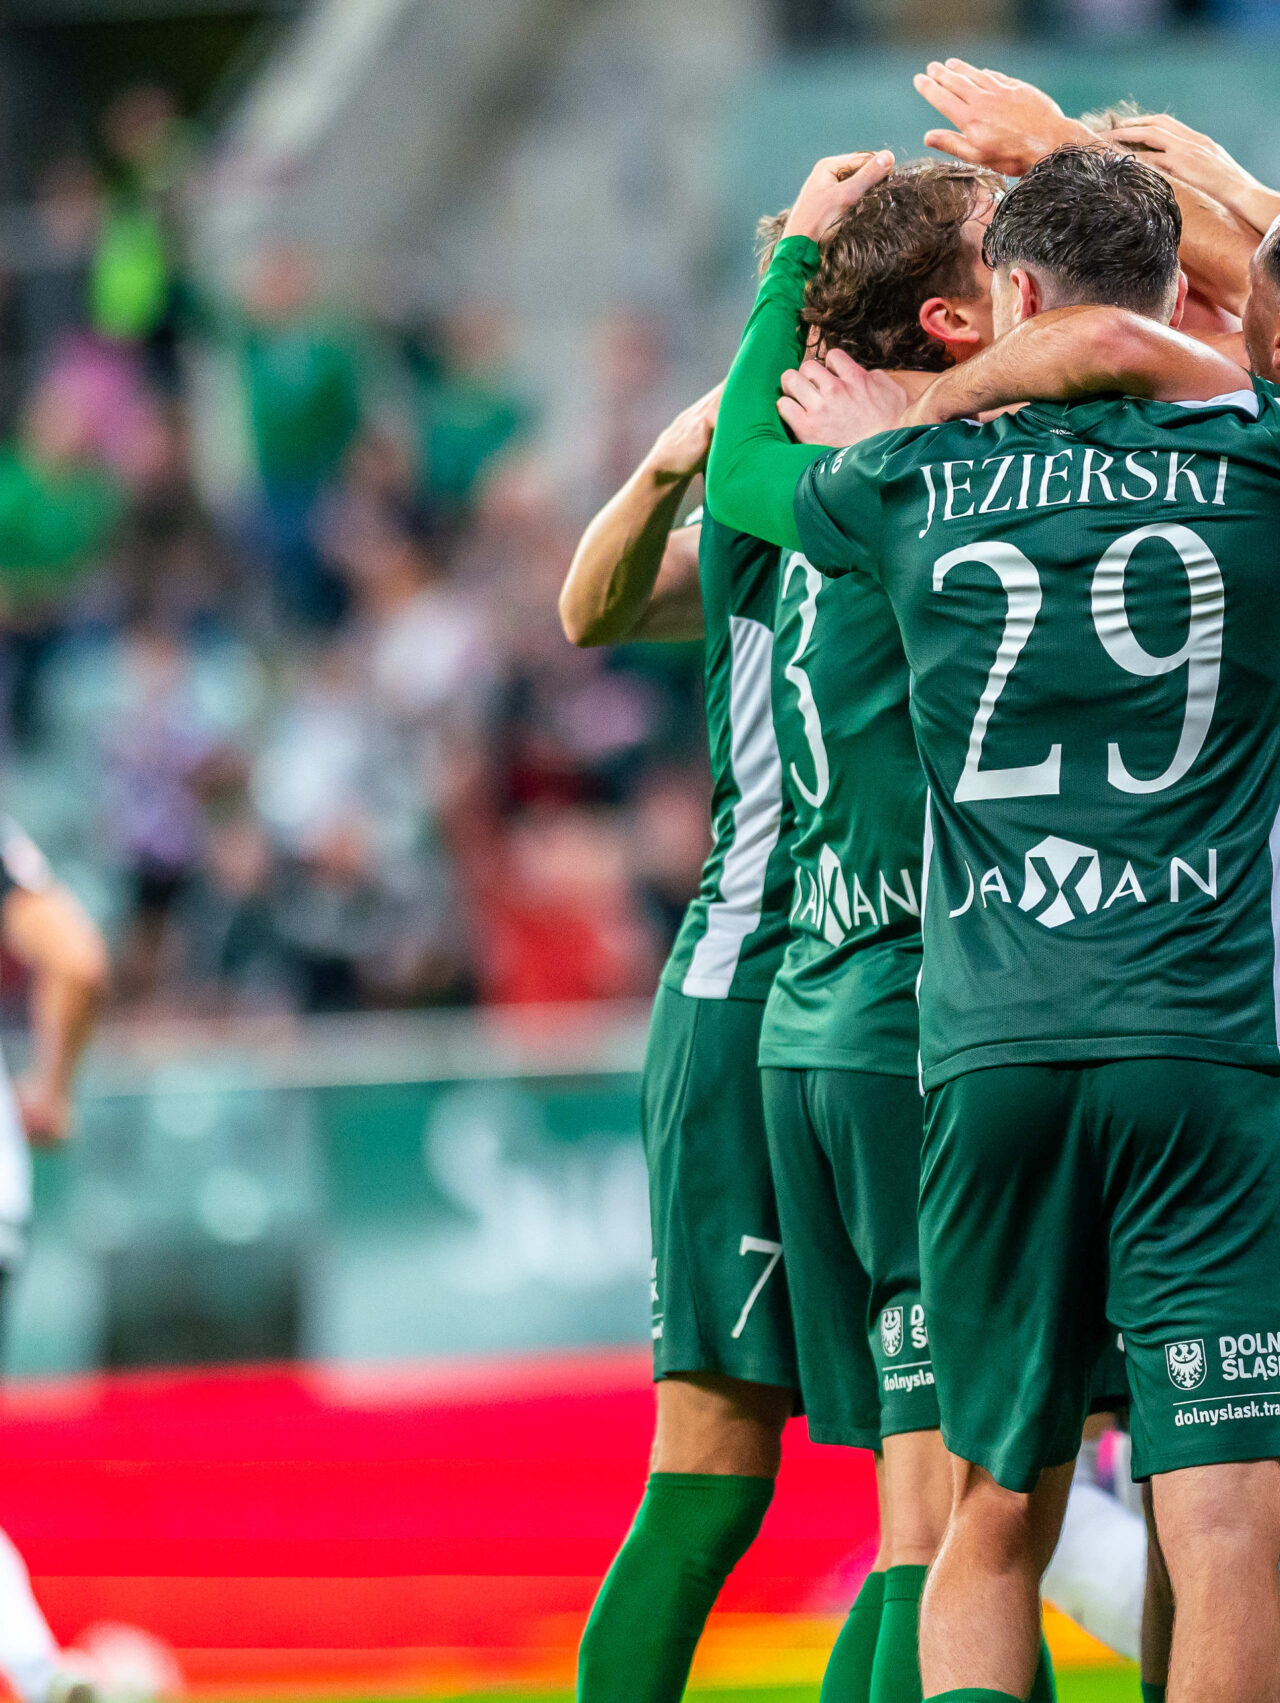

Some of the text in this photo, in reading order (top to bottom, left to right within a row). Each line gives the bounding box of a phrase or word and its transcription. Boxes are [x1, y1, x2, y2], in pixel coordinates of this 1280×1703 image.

[919, 446, 1229, 538] JEZIERSKI
[783, 551, 830, 809] 3
[933, 522, 1226, 803] 29
[788, 843, 921, 948] JAXAN
[948, 834, 1218, 929] JAXAN
[730, 1234, 783, 1339] 7
[883, 1369, 935, 1392] dolnysla
